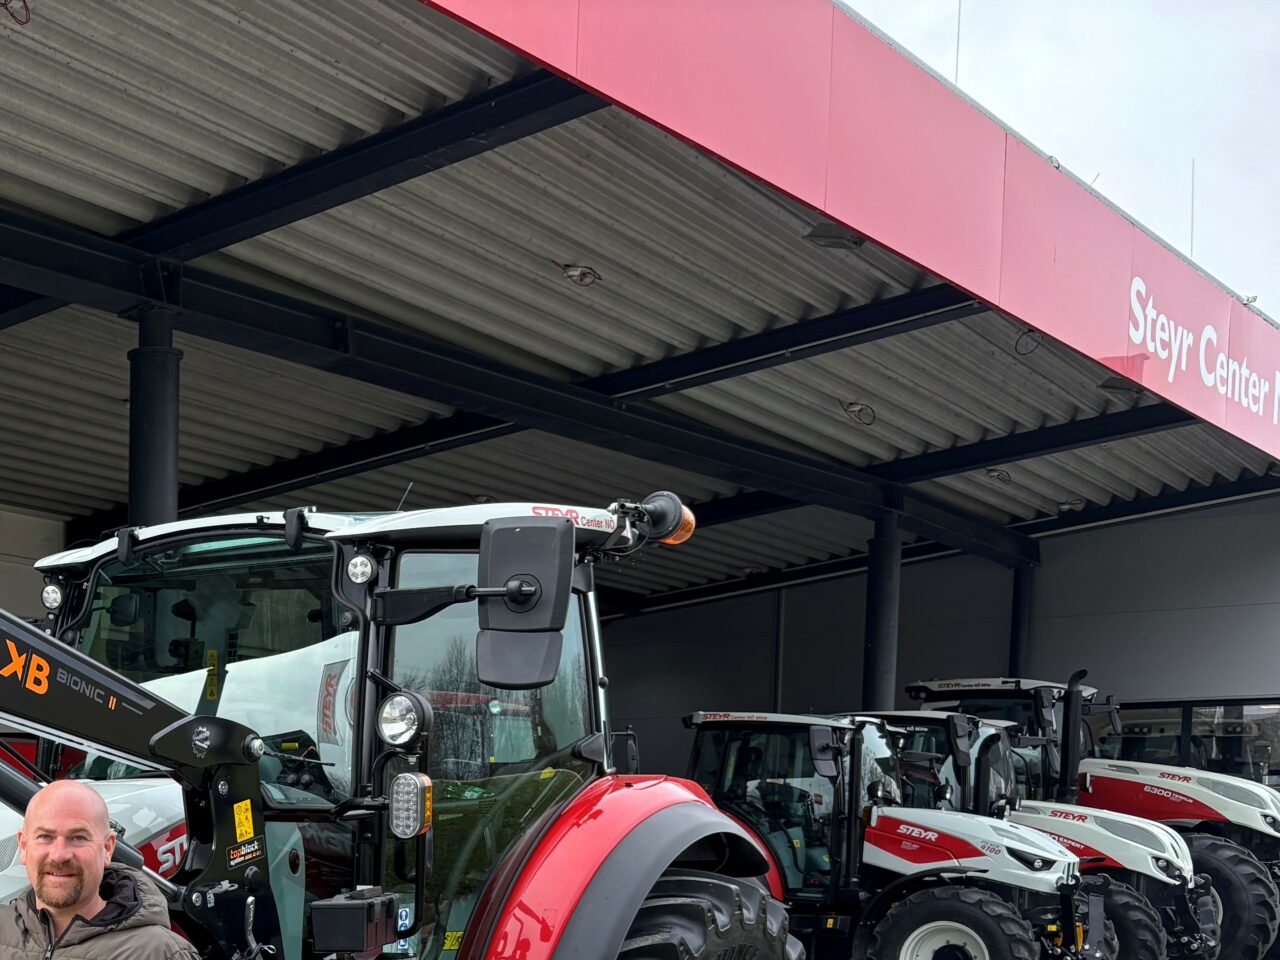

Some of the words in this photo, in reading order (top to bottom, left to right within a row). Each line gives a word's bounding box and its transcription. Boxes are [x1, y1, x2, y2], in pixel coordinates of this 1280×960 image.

[1129, 276, 1194, 383] Steyr
[1199, 324, 1269, 416] Center
[581, 517, 603, 528] Center
[56, 668, 105, 703] BIONIC
[703, 713, 731, 721] STEYR
[1158, 771, 1192, 784] STEYR
[1144, 785, 1172, 798] 6300
[1048, 809, 1088, 823] STEYR
[897, 825, 938, 841] STEYR
